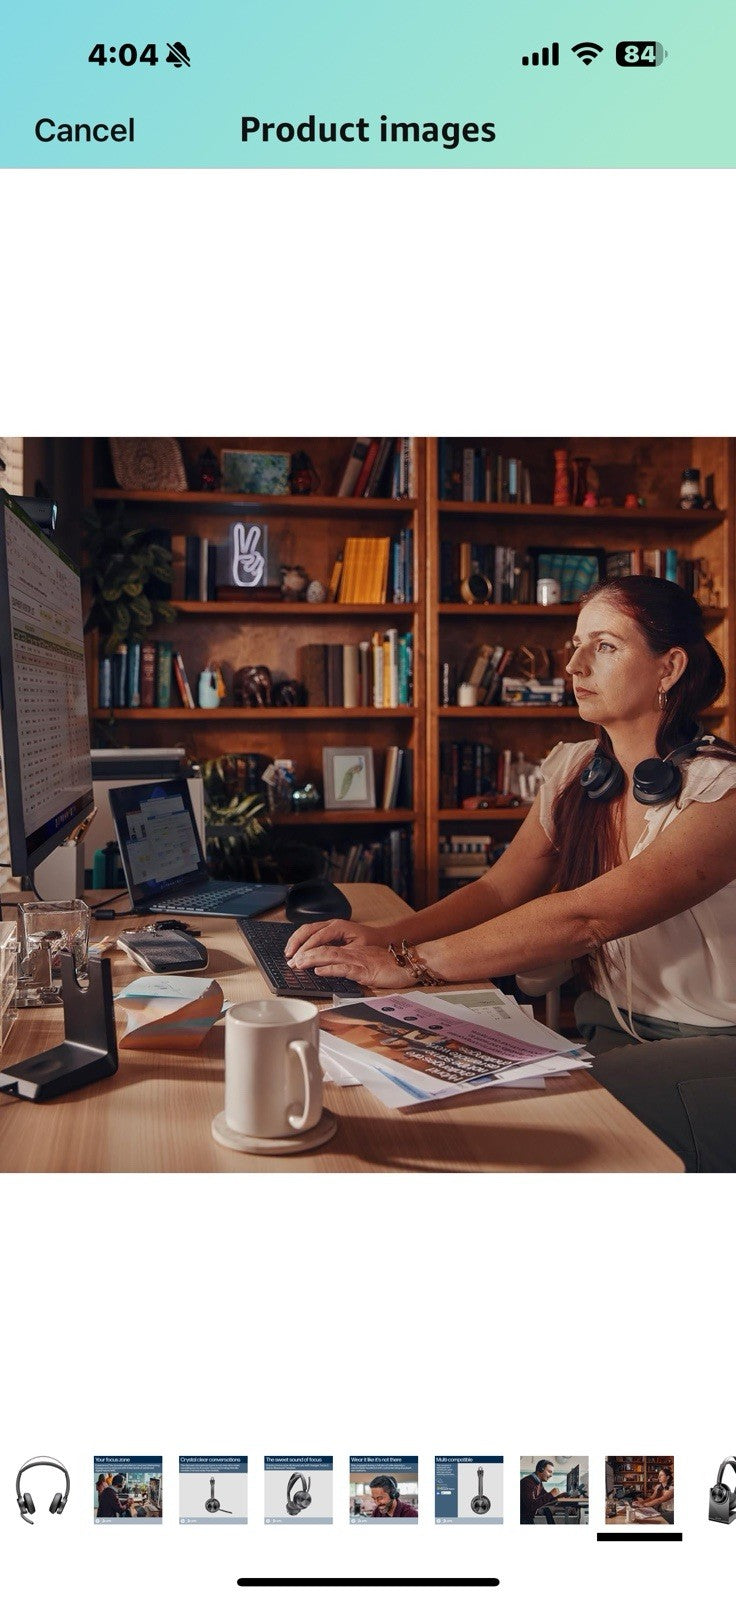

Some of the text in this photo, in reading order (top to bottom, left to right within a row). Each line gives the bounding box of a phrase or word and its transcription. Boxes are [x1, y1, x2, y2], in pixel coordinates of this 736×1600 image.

[88, 43, 159, 66] 4:04
[624, 45, 656, 63] 84
[35, 117, 135, 143] Cancel
[241, 114, 496, 150] Product images
